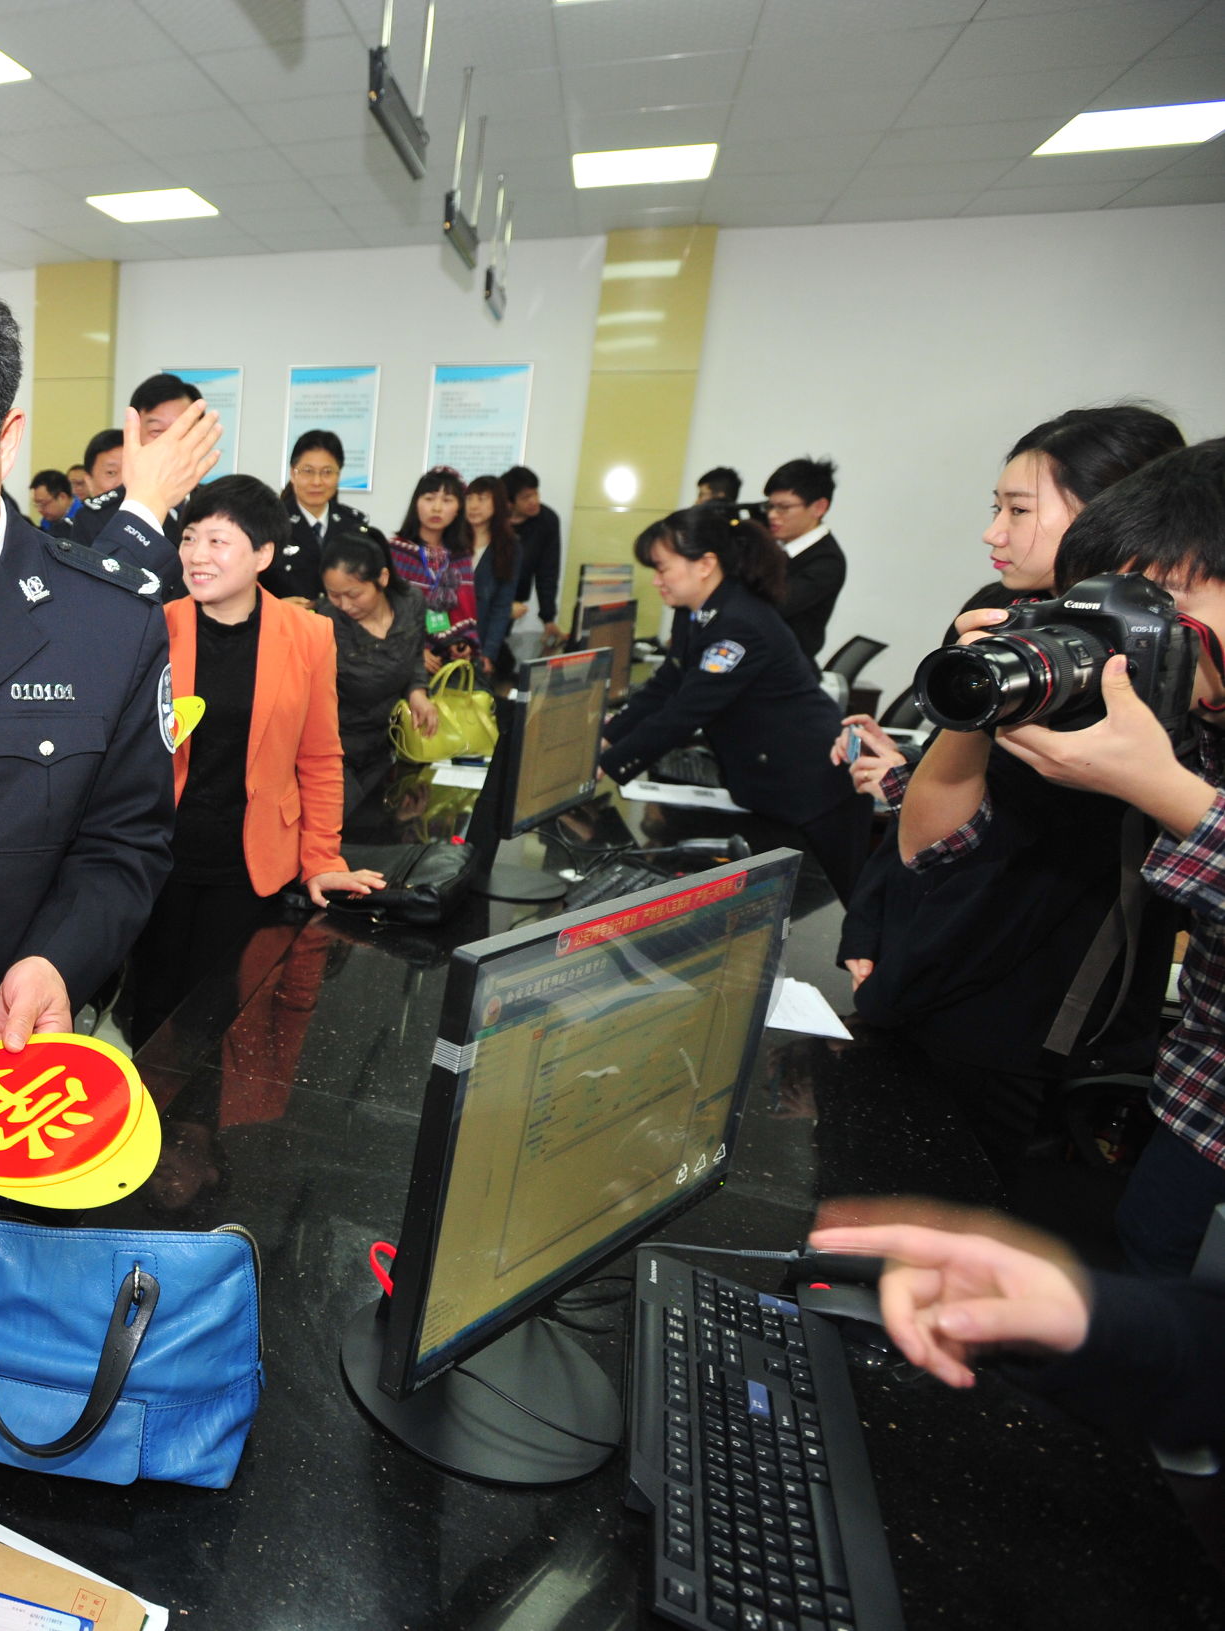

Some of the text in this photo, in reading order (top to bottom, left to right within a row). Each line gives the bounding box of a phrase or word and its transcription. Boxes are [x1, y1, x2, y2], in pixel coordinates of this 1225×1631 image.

[124, 525, 150, 547] POLICE
[1064, 600, 1101, 610] Canon
[648, 1259, 658, 1284] lenovo
